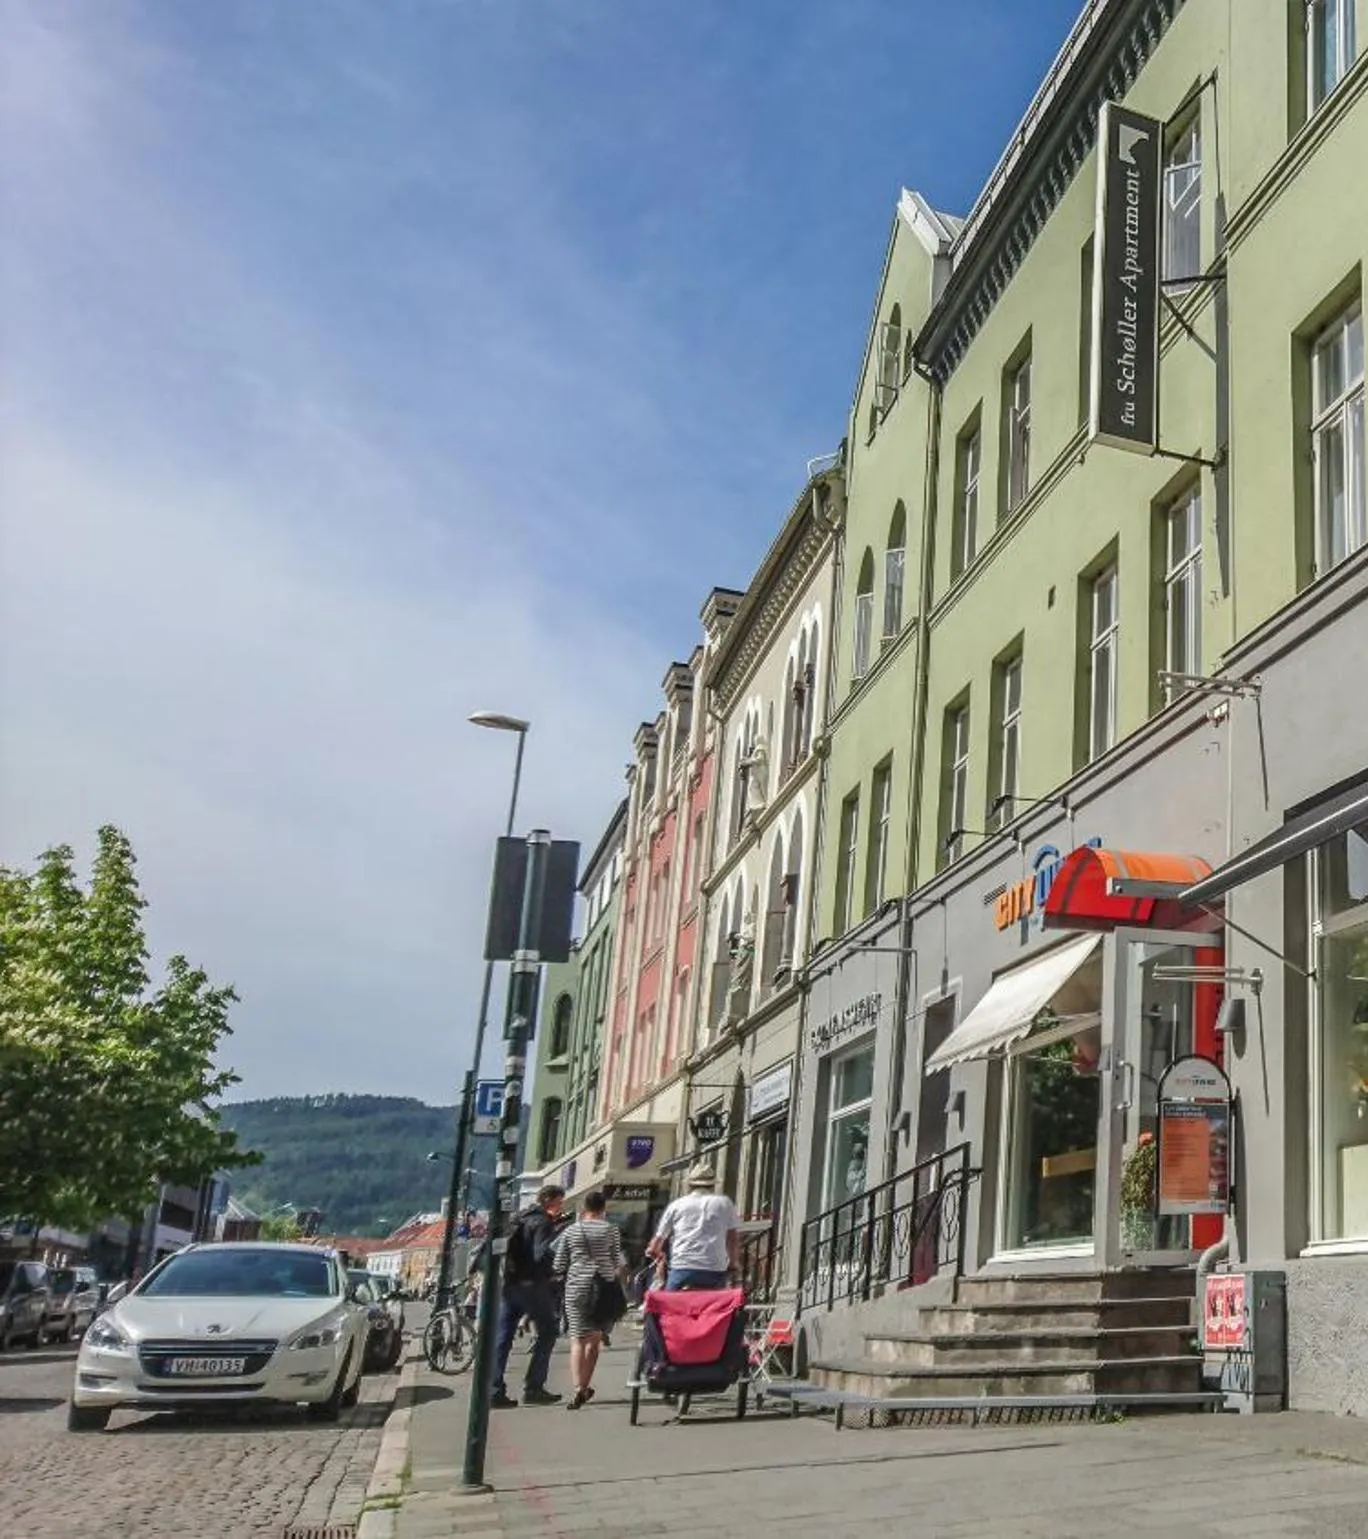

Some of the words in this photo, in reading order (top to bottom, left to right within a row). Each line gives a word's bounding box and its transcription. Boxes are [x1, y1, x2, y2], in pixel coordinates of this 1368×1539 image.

[1118, 168, 1145, 293] Apartment
[1116, 296, 1138, 395] Schøller
[1120, 401, 1136, 427] fru
